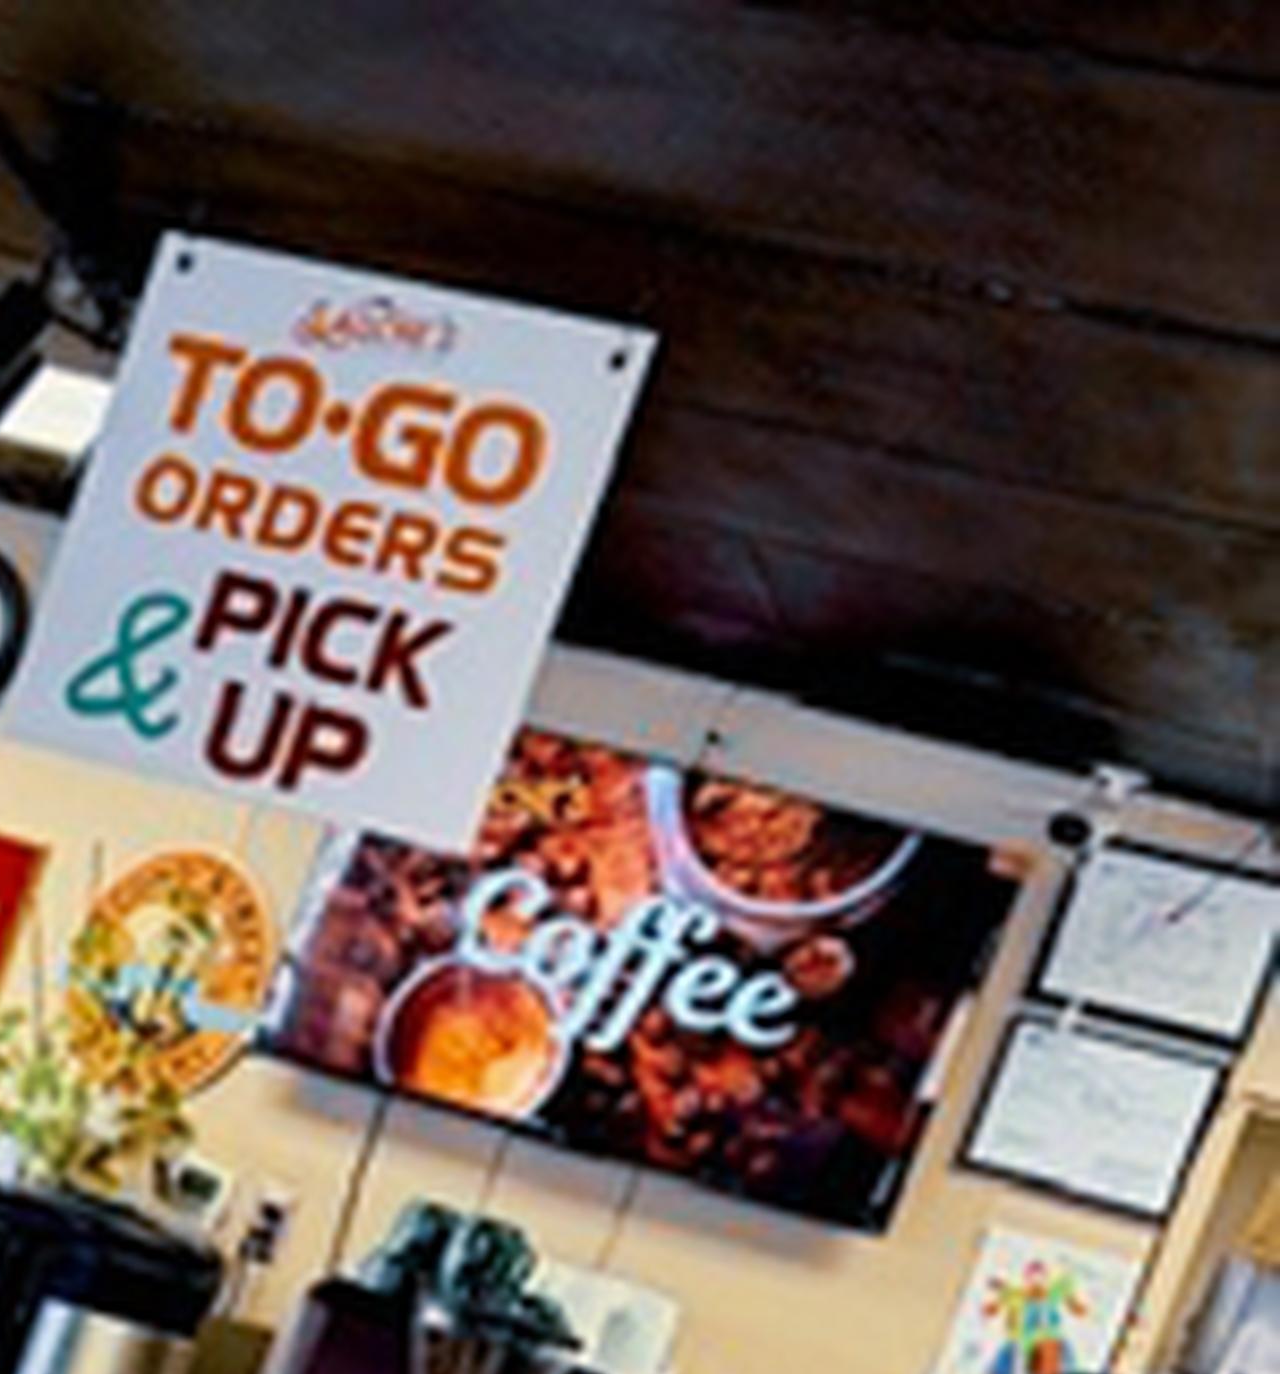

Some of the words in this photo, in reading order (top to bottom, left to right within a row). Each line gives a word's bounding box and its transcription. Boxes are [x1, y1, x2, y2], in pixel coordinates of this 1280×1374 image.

[135, 454, 506, 595] ORDERS
[64, 592, 191, 740] &
[194, 570, 453, 710] PICK
[203, 681, 370, 792] UP
[456, 868, 798, 1052] Coffee
